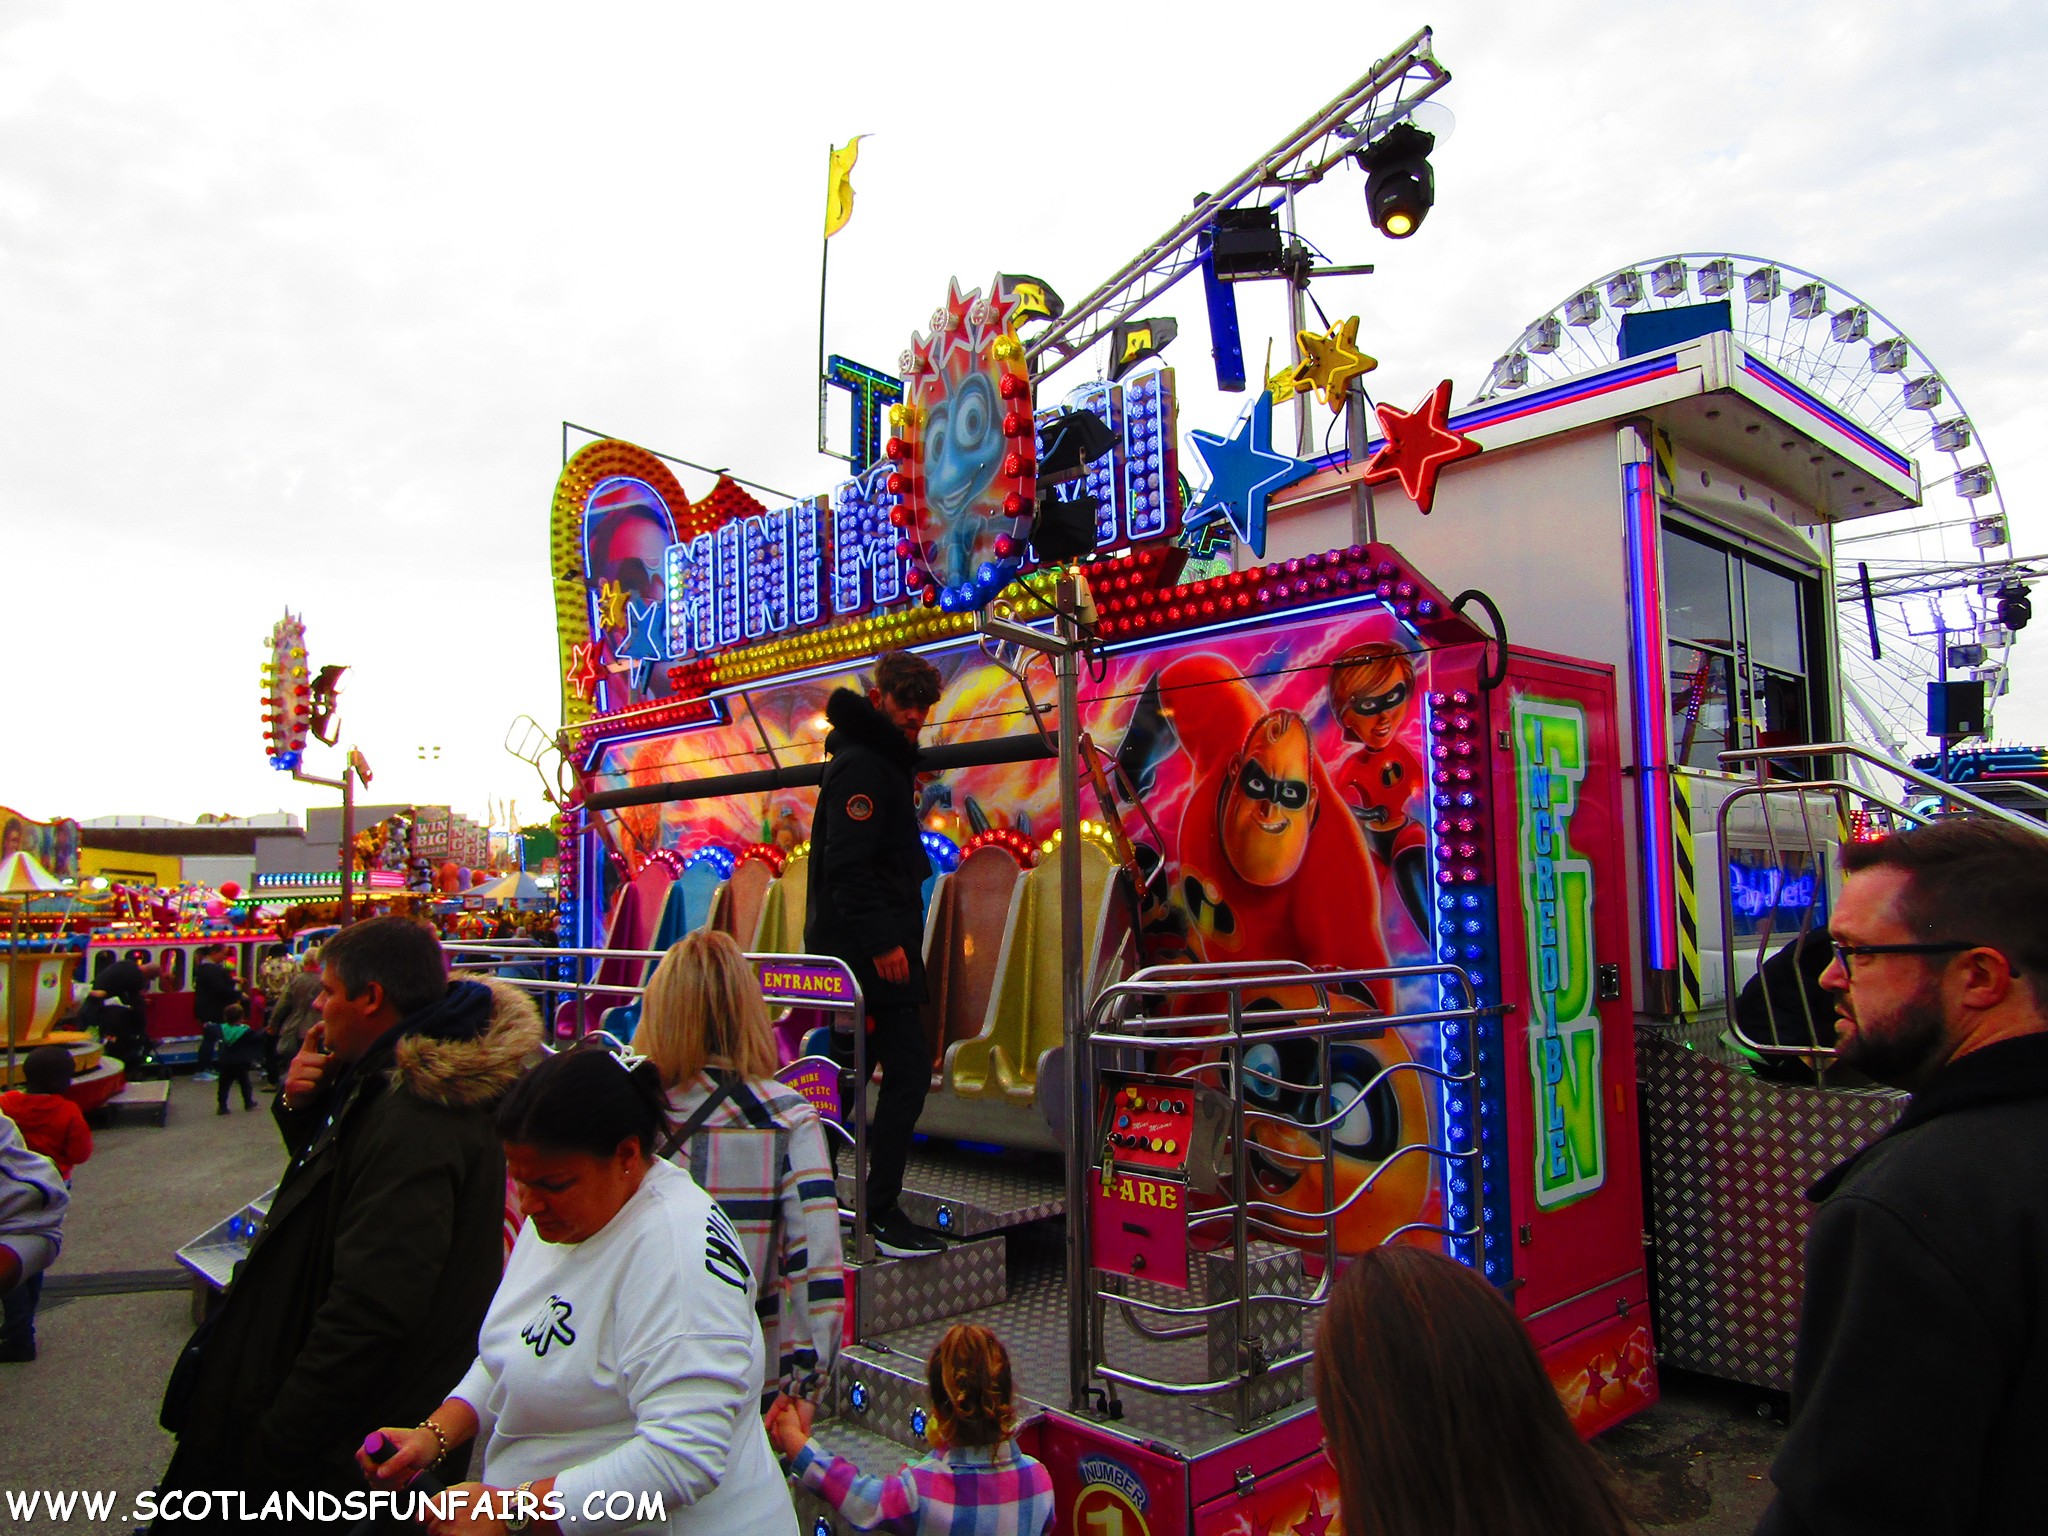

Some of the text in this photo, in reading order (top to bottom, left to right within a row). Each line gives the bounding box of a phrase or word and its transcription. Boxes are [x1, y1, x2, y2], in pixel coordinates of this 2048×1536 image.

[665, 494, 828, 660] MINI
[416, 820, 449, 834] WIN
[416, 833, 447, 847] BIG
[1514, 700, 1604, 1206] FUN
[1531, 718, 1568, 1179] INCREDIBLE
[763, 972, 842, 993] ENTRANCE
[785, 1072, 819, 1089] OR HIRE
[816, 1085, 830, 1096] ETC
[1082, 1461, 1146, 1511] NUMBER
